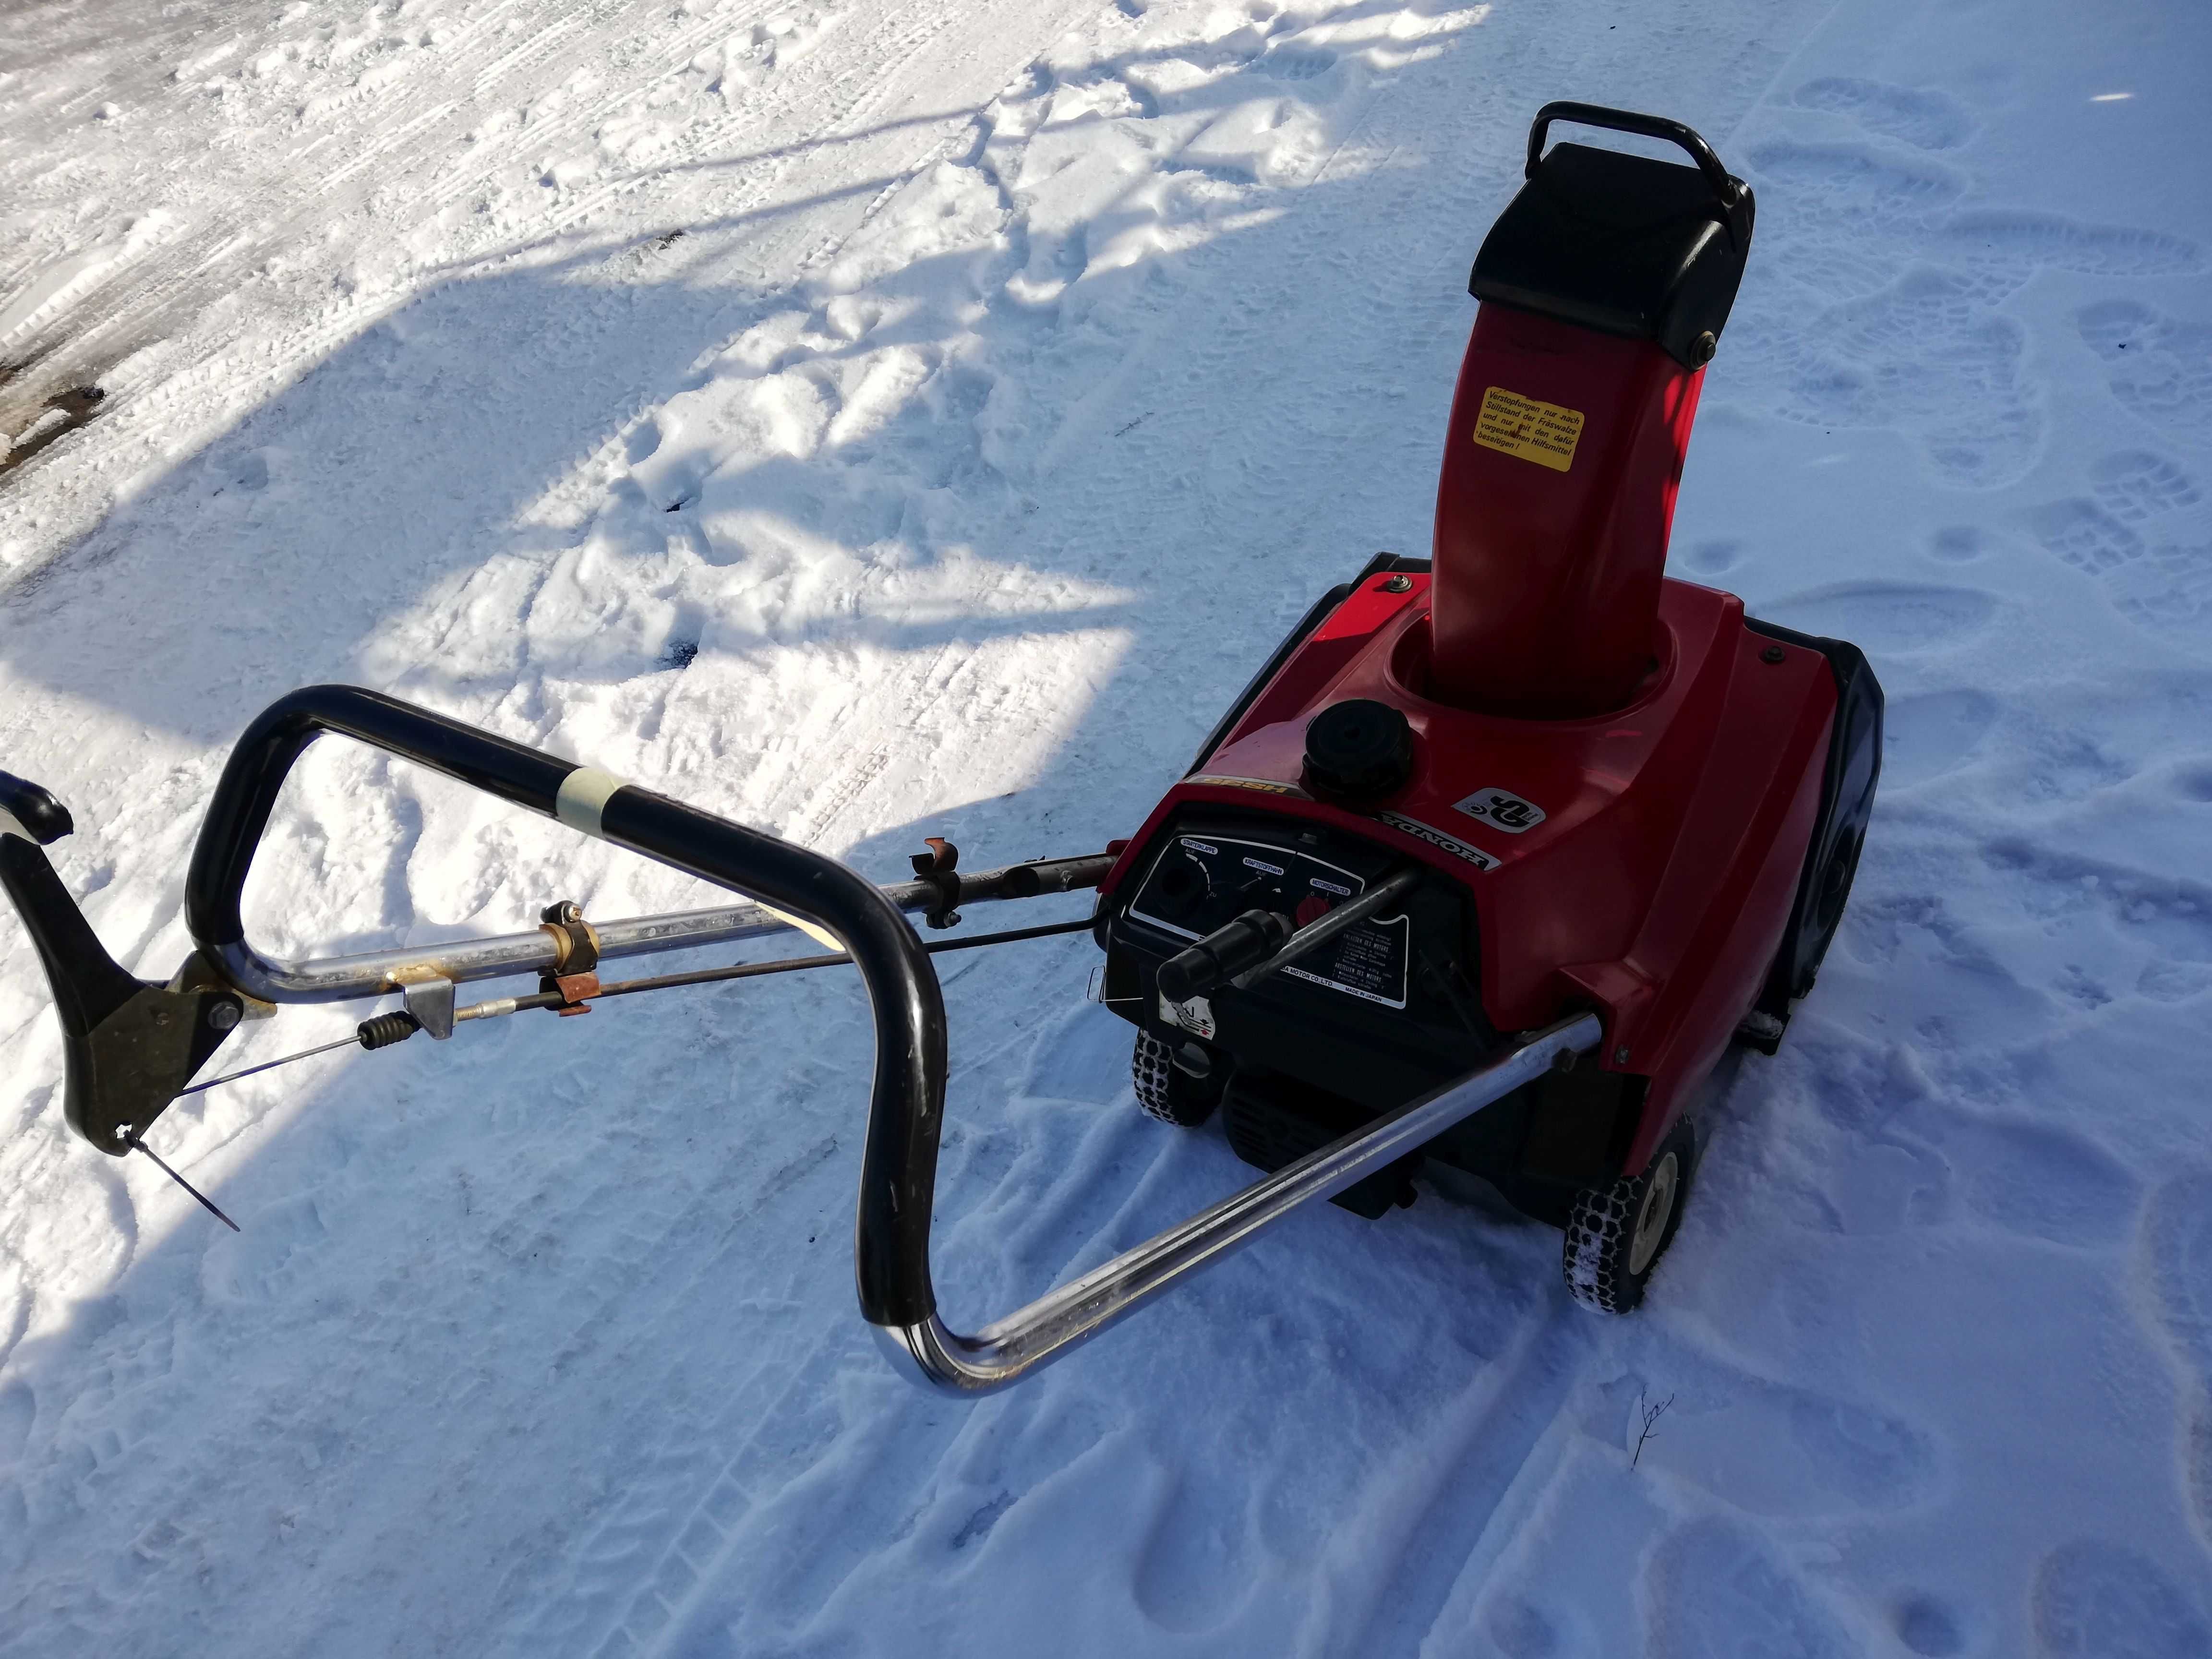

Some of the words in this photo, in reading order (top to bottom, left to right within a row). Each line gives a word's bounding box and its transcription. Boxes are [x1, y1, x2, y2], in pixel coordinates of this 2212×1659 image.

[1490, 391, 1540, 412] Verstopfungen
[1544, 409, 1558, 418] nur
[1561, 415, 1580, 425] nach
[1486, 401, 1521, 417] Stillstand
[1523, 413, 1535, 422] der
[1538, 418, 1576, 435] Fräswalze
[1483, 412, 1497, 421] und
[1501, 418, 1514, 426] nur
[1518, 423, 1531, 432] mit
[1535, 428, 1549, 438] den
[1553, 433, 1575, 445] dafür
[1478, 432, 1514, 448] beseitigen
[1531, 437, 1572, 456] Hilfsmittel
[1182, 840, 1216, 854] STARTERKLAPPE
[1381, 814, 1485, 866] HONDA
[1245, 859, 1283, 875] KRAFTSTOFFHAHN
[1312, 879, 1349, 895] MOTORSCHALTER
[1290, 968, 1310, 979] MOTOR
[1345, 986, 1359, 995] MADE
[1366, 994, 1382, 1002] JAPAN
